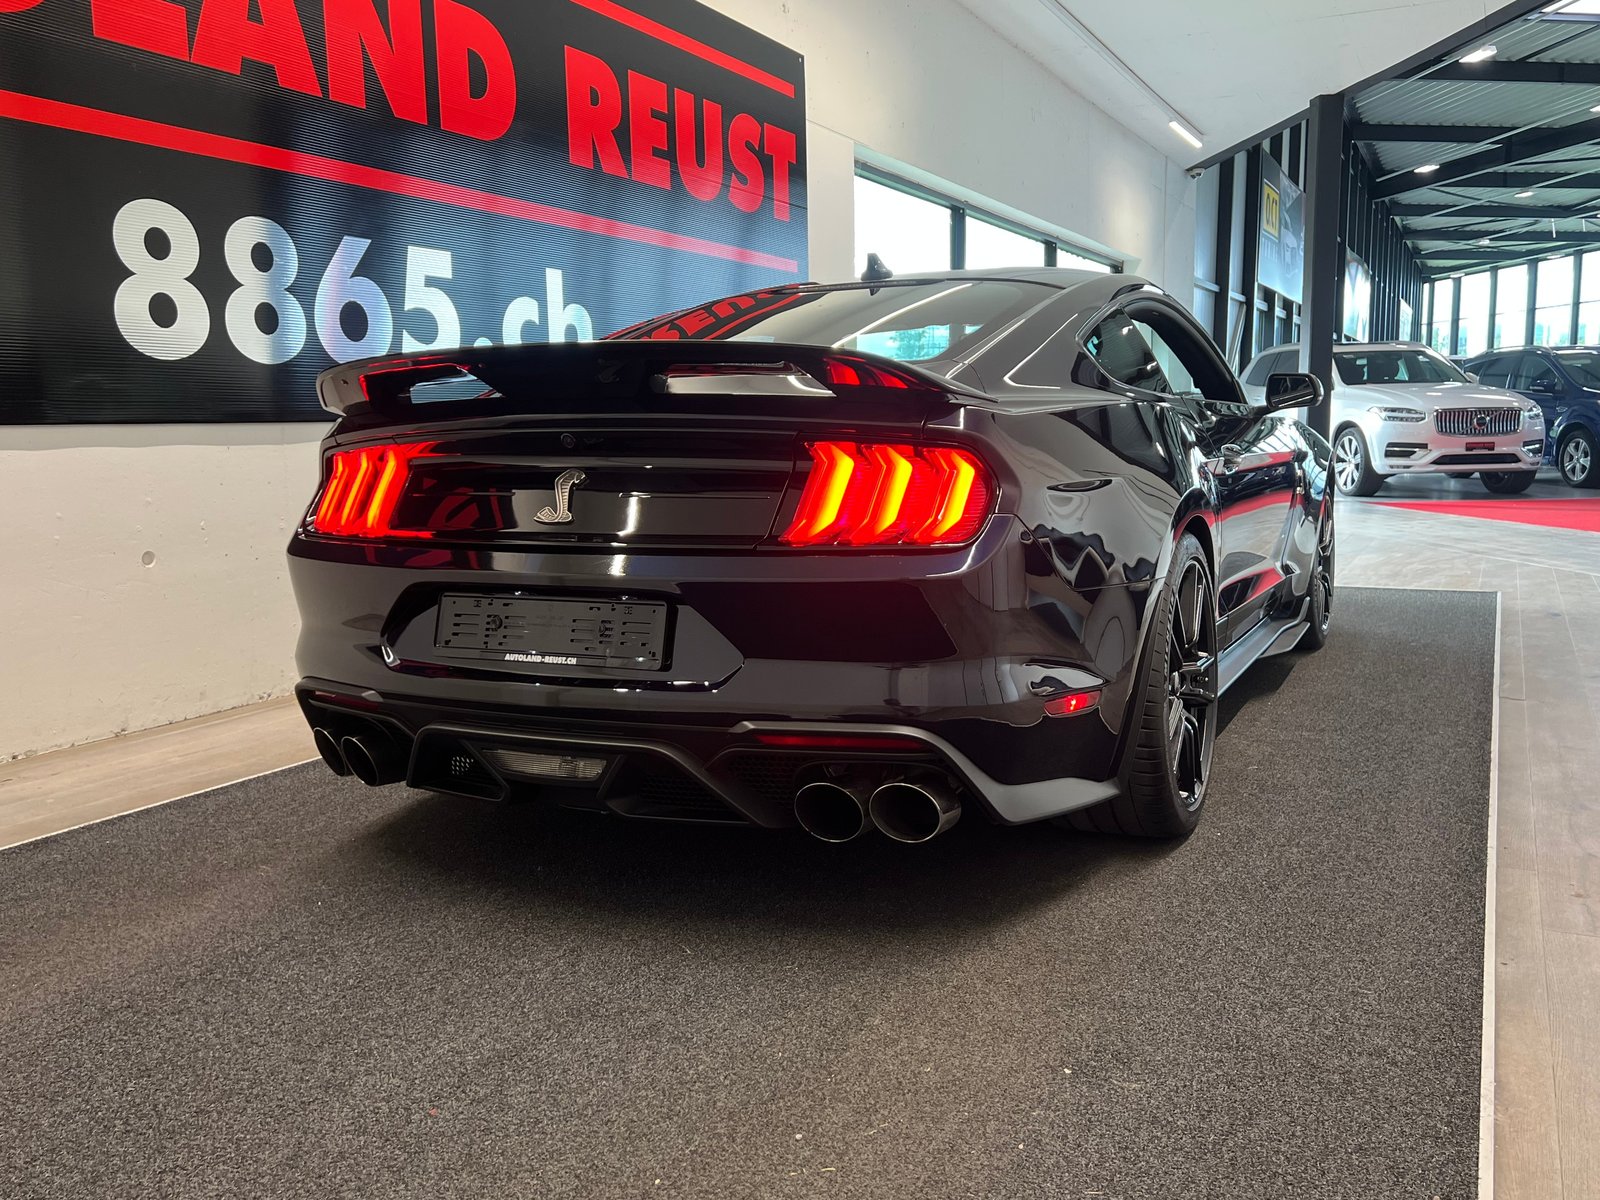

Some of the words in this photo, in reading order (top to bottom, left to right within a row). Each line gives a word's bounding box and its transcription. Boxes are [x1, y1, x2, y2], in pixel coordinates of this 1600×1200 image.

[0, 0, 517, 142] AND
[563, 44, 798, 223] REUST
[504, 653, 577, 664] AUTOLAND-REUST.CH
